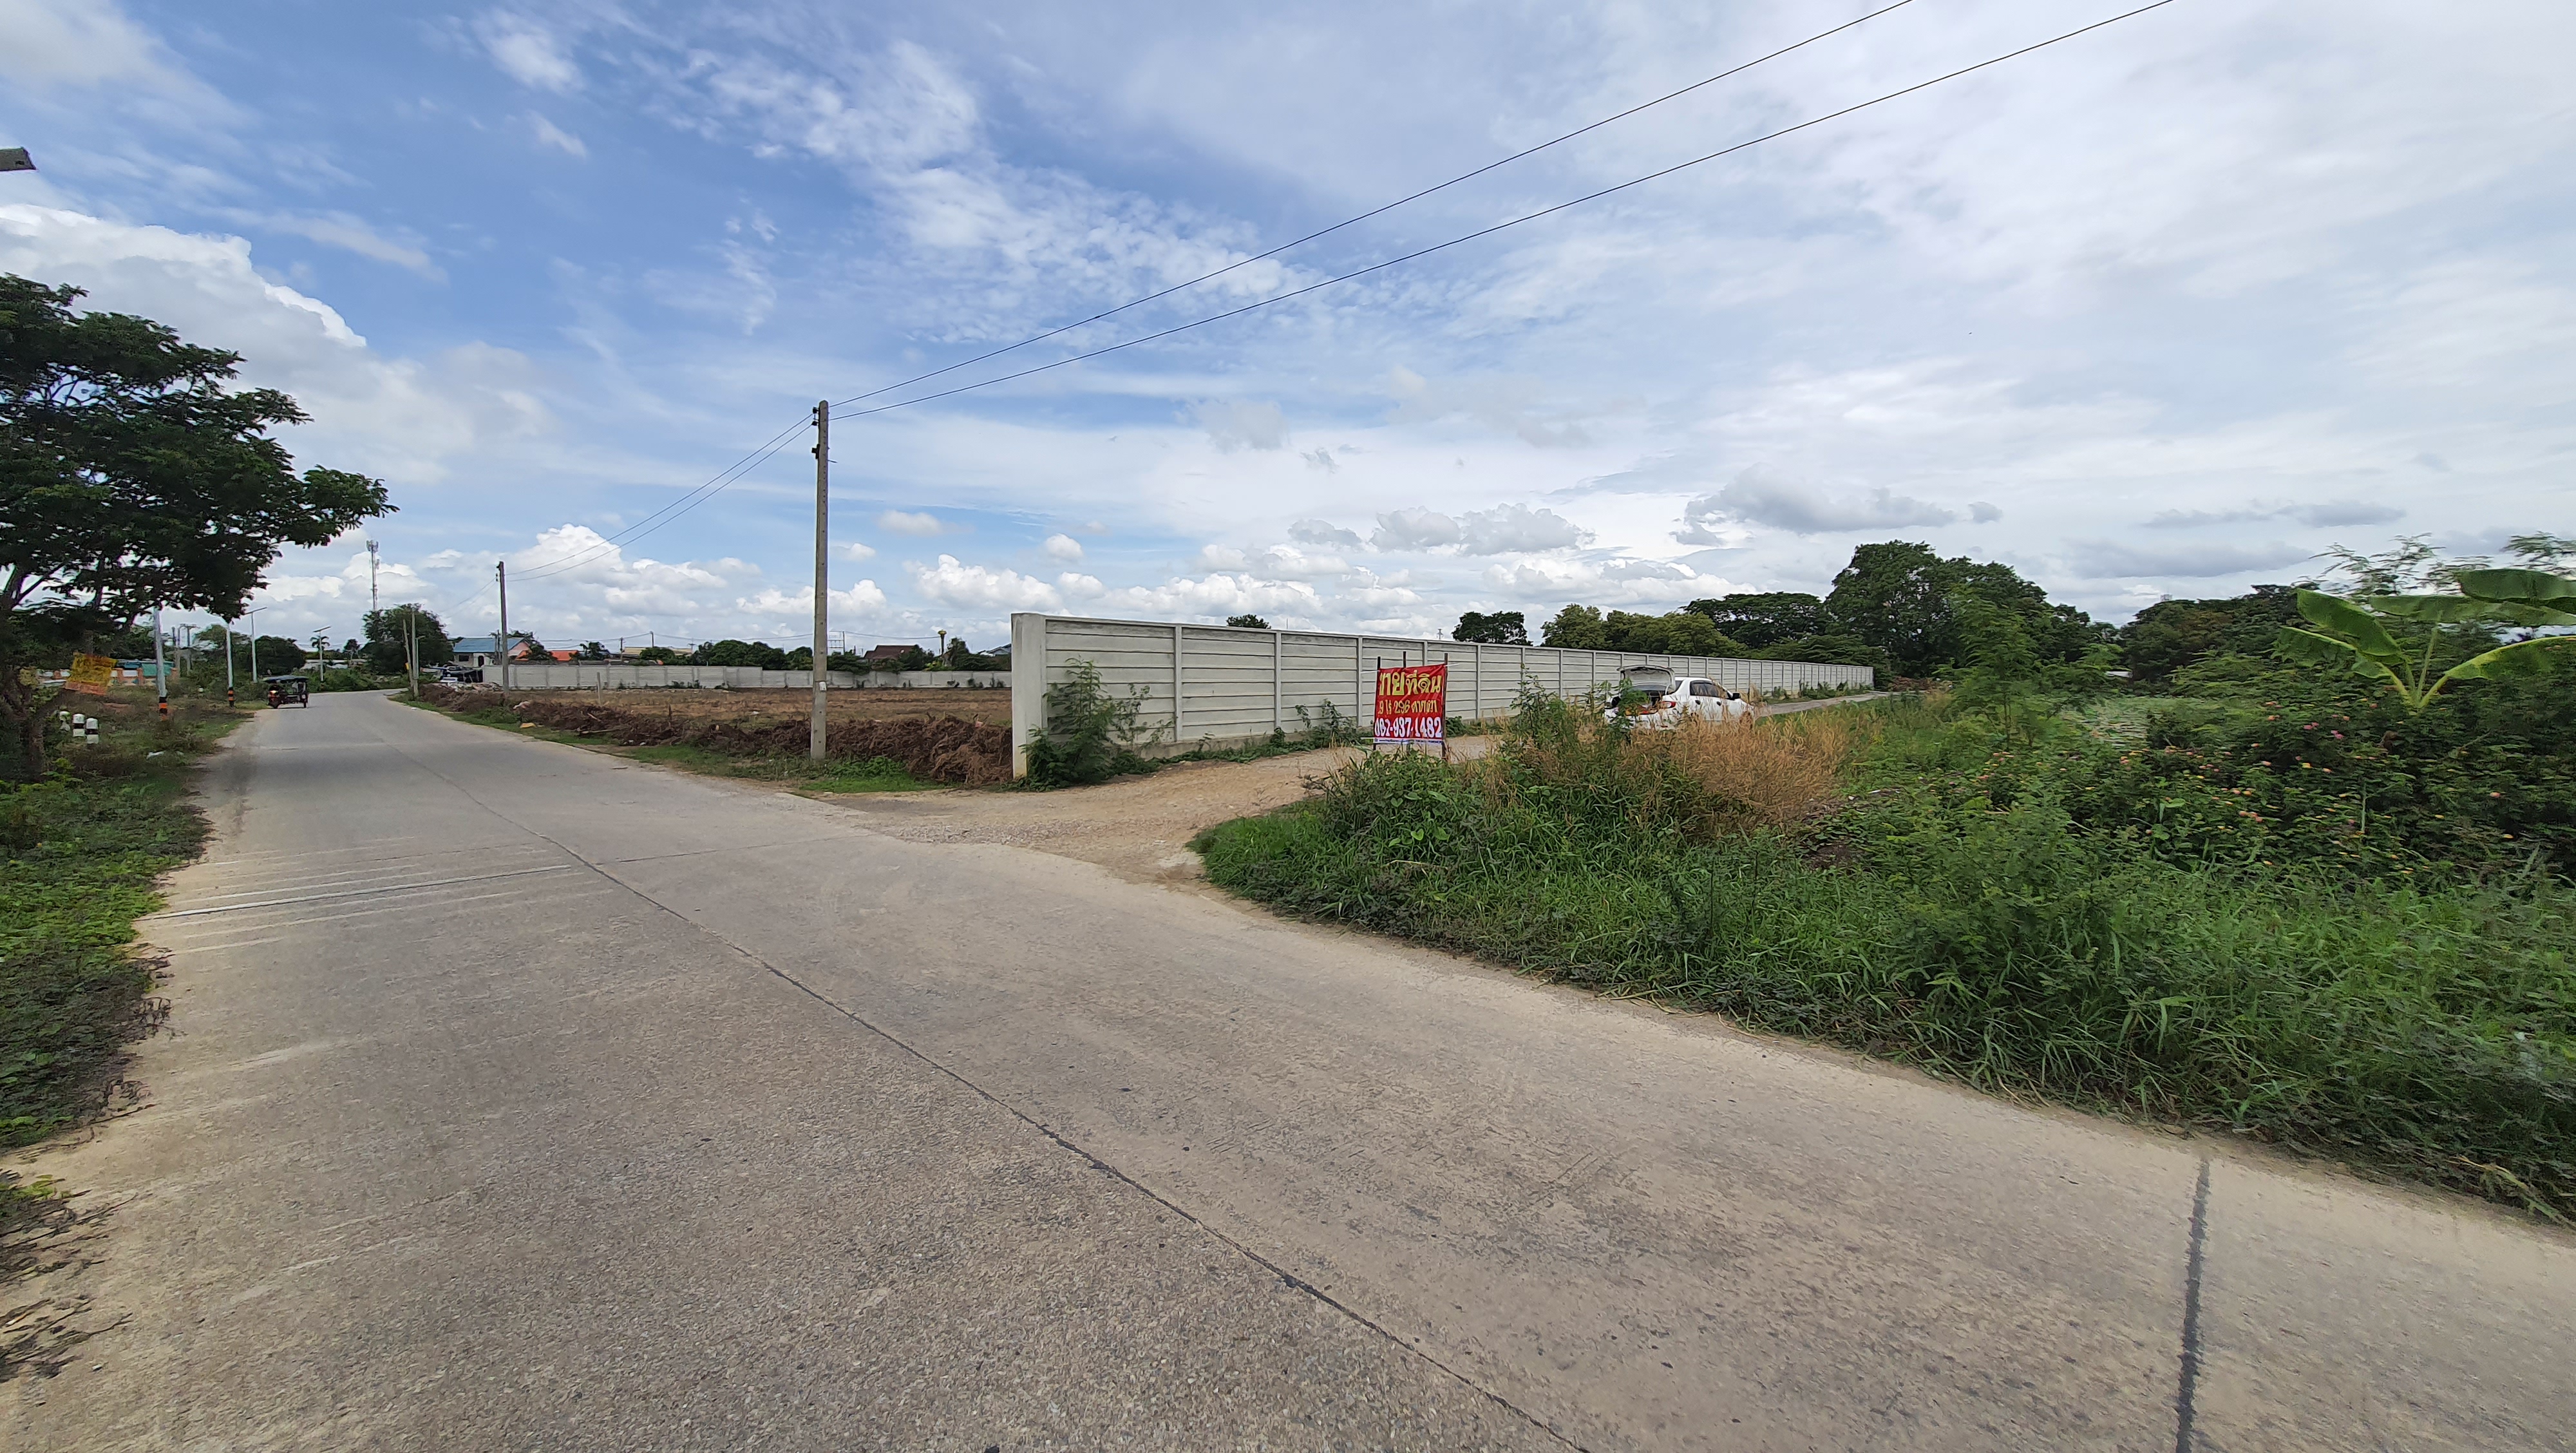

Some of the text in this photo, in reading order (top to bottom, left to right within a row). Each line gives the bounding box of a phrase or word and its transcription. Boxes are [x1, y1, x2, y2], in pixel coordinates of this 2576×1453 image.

[1379, 669, 1442, 696] ขายที่ดิน
[1378, 700, 1384, 715] 9
[1394, 699, 1410, 714] 296
